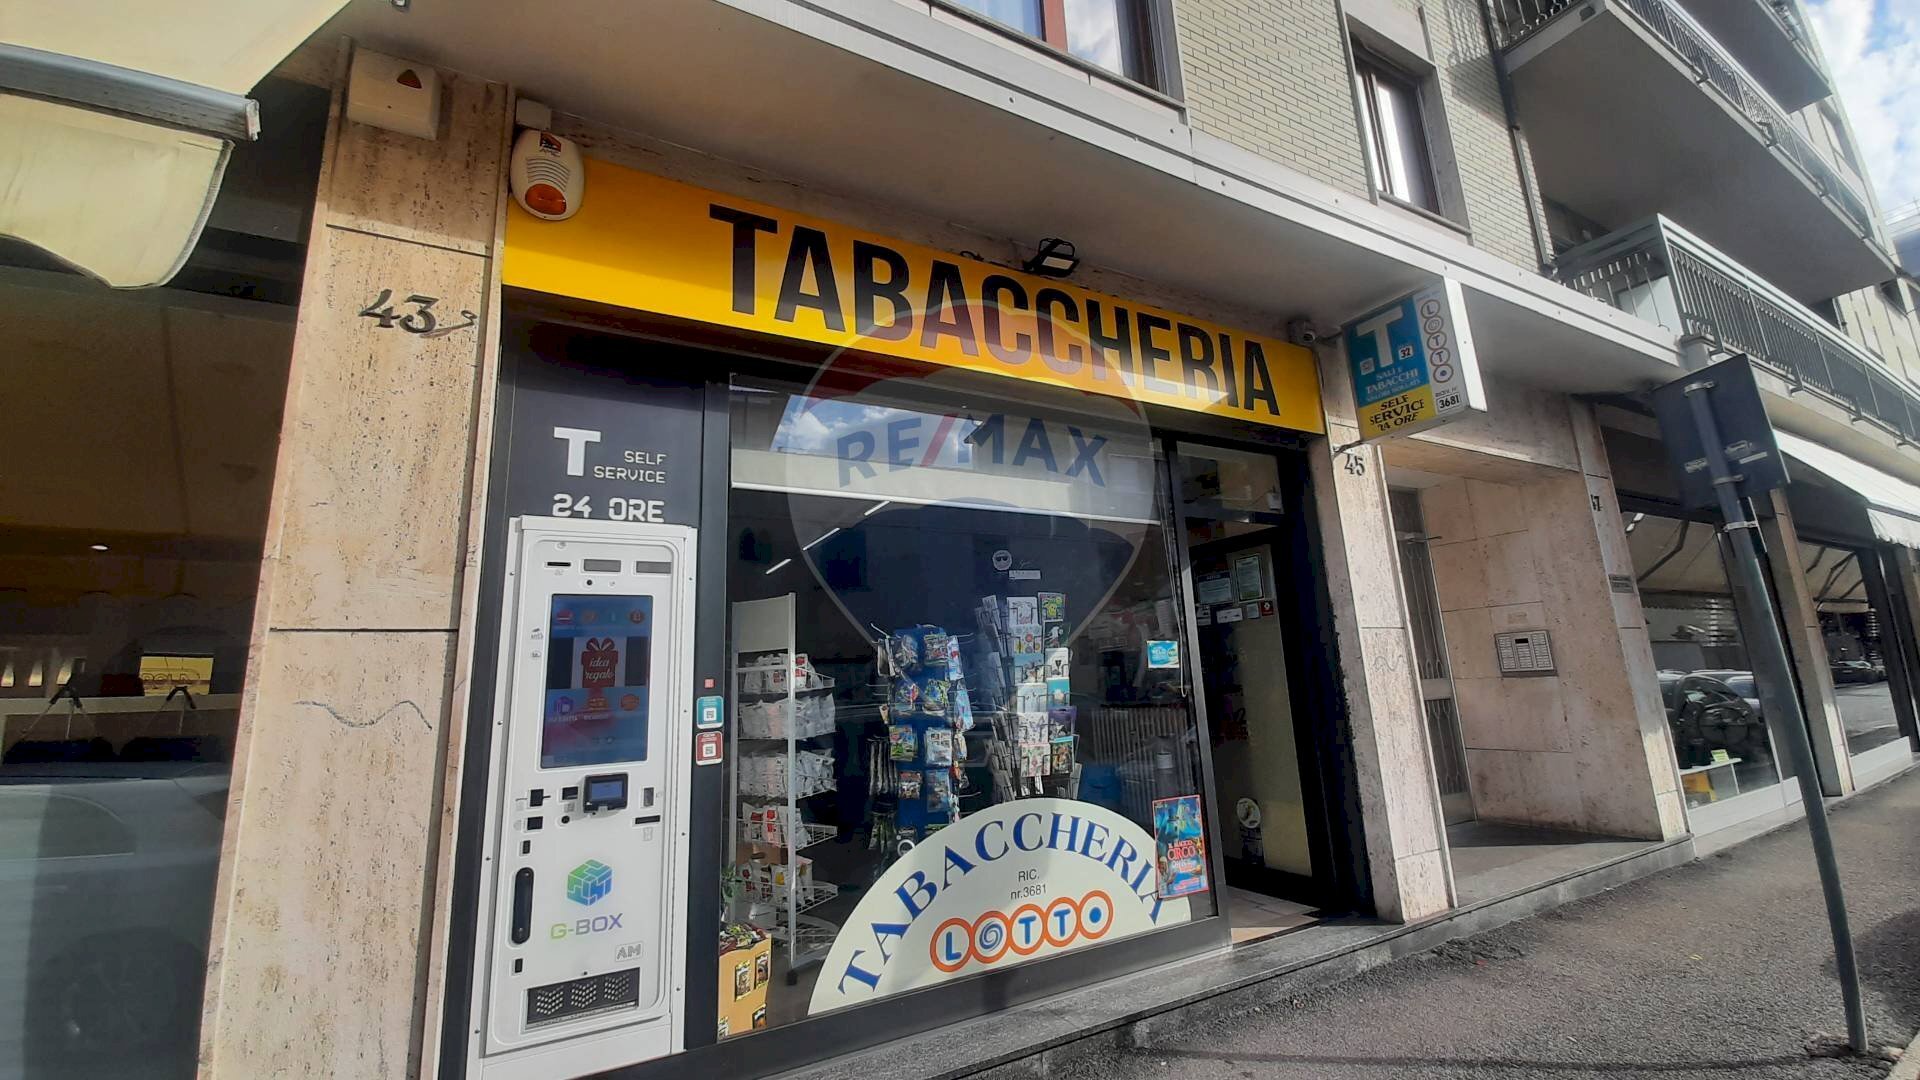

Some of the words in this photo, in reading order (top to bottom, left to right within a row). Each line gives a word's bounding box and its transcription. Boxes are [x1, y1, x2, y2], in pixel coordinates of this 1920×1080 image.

[358, 288, 440, 334] 43
[709, 203, 1282, 417] TABACCHERIA
[1356, 306, 1404, 368] T
[1420, 299, 1454, 383] LOTTO
[1400, 348, 1412, 359] 32
[1366, 368, 1419, 394] TABACCHI
[1370, 398, 1425, 426] SERVICE
[1380, 394, 1409, 411] SELF
[1438, 395, 1460, 409] 3681
[553, 426, 601, 476] T
[623, 450, 667, 465] SELF
[593, 465, 667, 484] SERVICE
[1344, 453, 1365, 477] 45
[552, 493, 593, 519] 24
[608, 497, 666, 523] ORE
[590, 657, 609, 667] idea
[1167, 845, 1196, 861] CIRCO
[1018, 868, 1040, 883] RIC.
[837, 812, 1164, 994] TABACCHERIA
[1010, 883, 1047, 900] nr.3681
[550, 912, 623, 940] G-BOX
[929, 889, 1114, 972] LOTTO
[616, 943, 642, 960] AM
